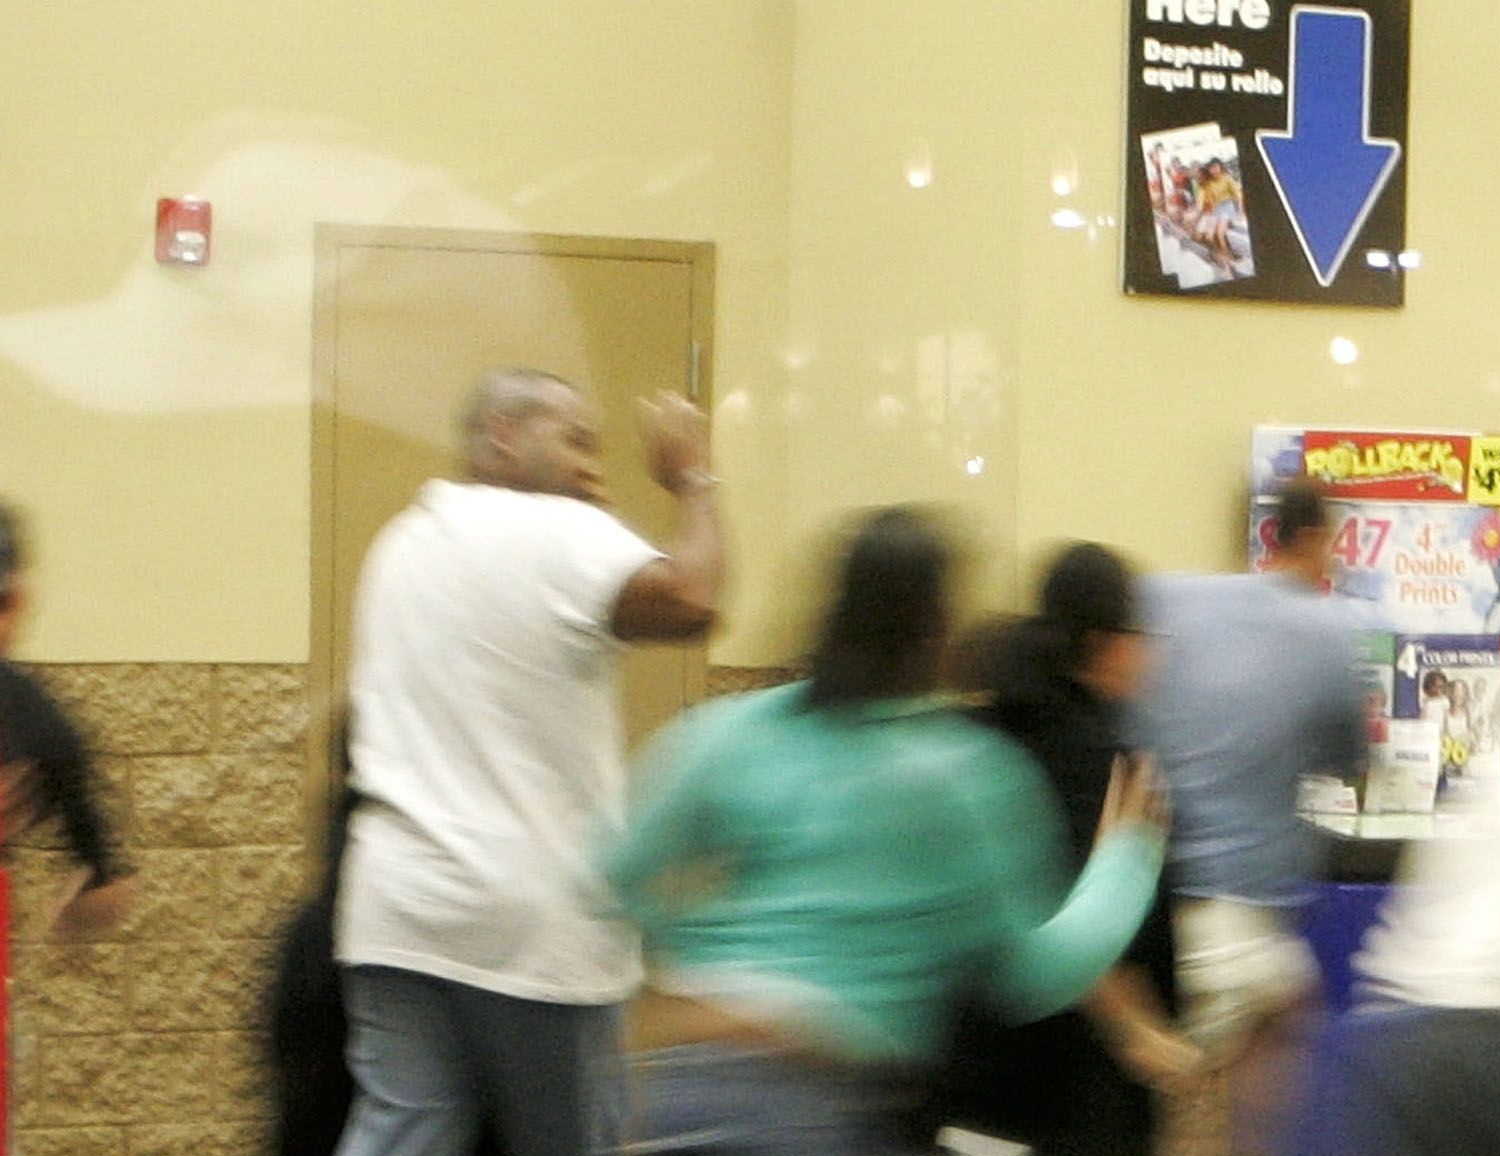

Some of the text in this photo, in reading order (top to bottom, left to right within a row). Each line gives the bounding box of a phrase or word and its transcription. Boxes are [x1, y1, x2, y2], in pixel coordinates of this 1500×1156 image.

[1200, 71, 1226, 90] su
[1231, 69, 1284, 95] rollo
[1305, 440, 1454, 481] ROLLBACK
[1395, 551, 1466, 577] Double
[1400, 580, 1458, 605] Prints
